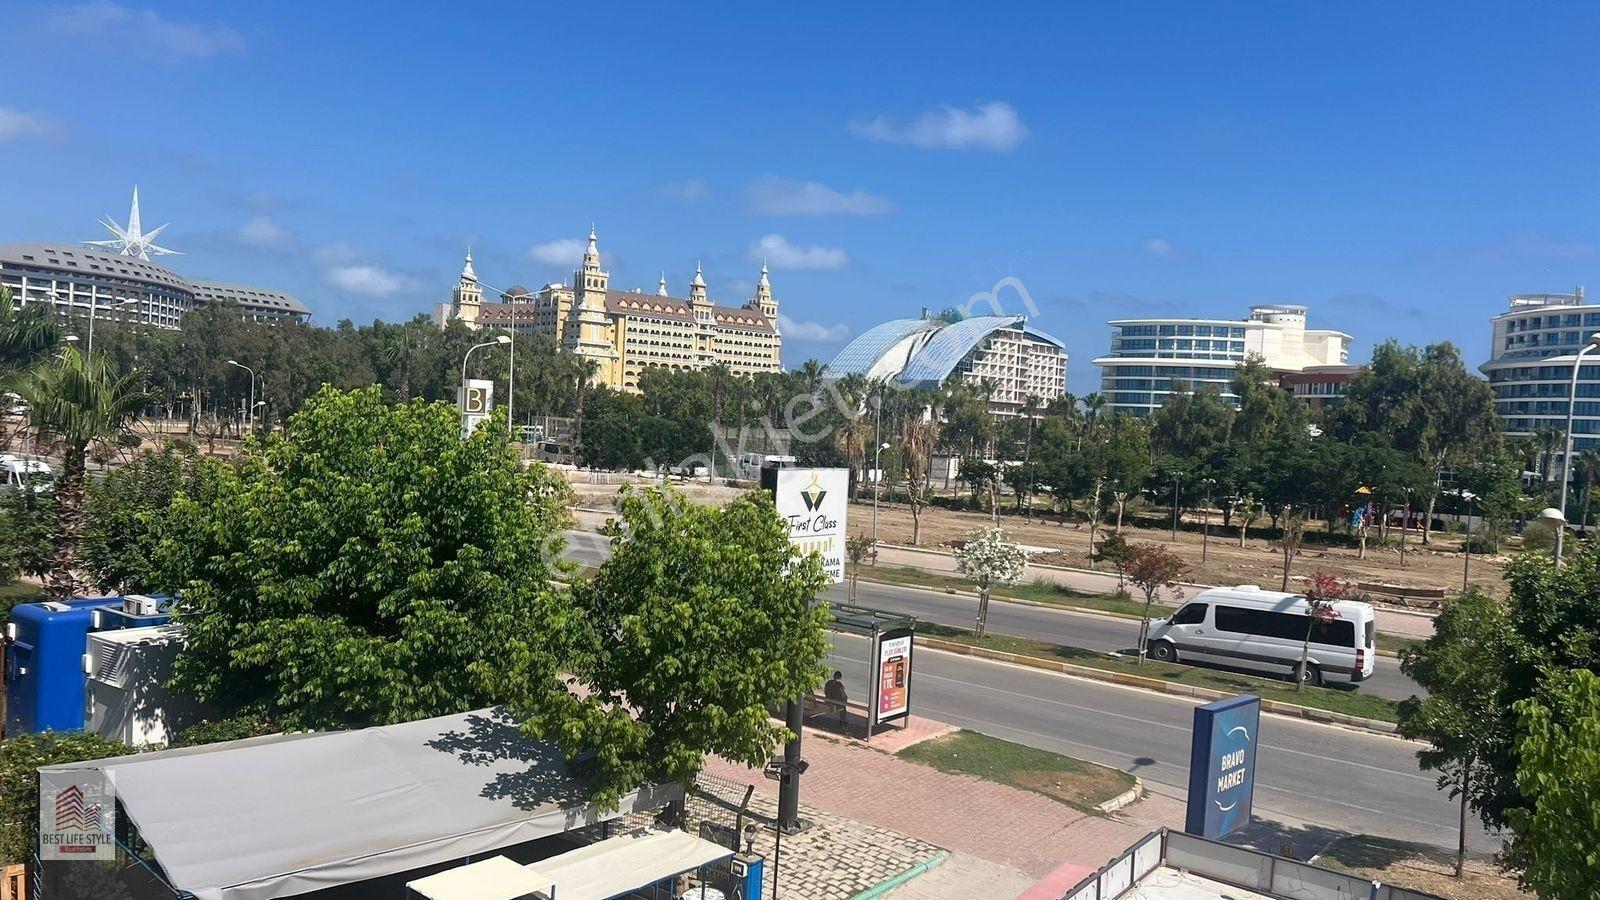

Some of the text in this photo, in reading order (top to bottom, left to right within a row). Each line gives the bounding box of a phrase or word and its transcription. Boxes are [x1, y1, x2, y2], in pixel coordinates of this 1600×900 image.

[787, 514, 837, 533] First Class
[1221, 749, 1245, 771] BRAVO
[1217, 768, 1246, 793] MARKET
